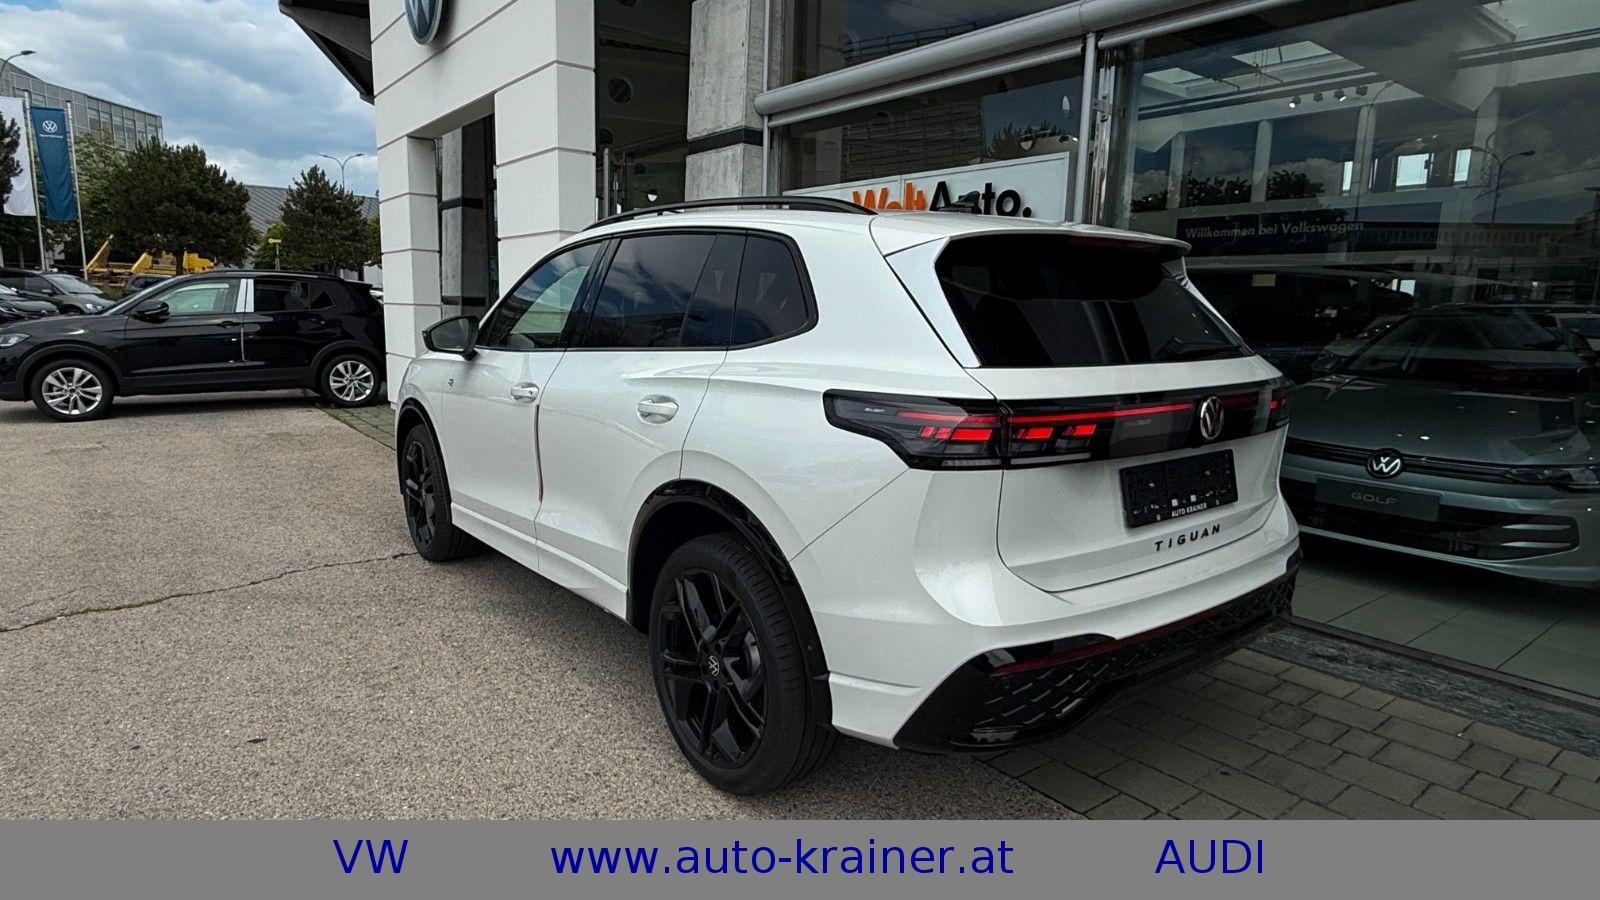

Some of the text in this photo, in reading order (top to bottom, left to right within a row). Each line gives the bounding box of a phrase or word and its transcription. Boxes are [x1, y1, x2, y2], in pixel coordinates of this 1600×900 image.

[1185, 220, 1364, 239] Willkommen bei Volkswagen
[1351, 491, 1398, 504] GOLF
[1171, 502, 1207, 517] AUTO KRAINER
[1154, 524, 1220, 551] TIGUAN
